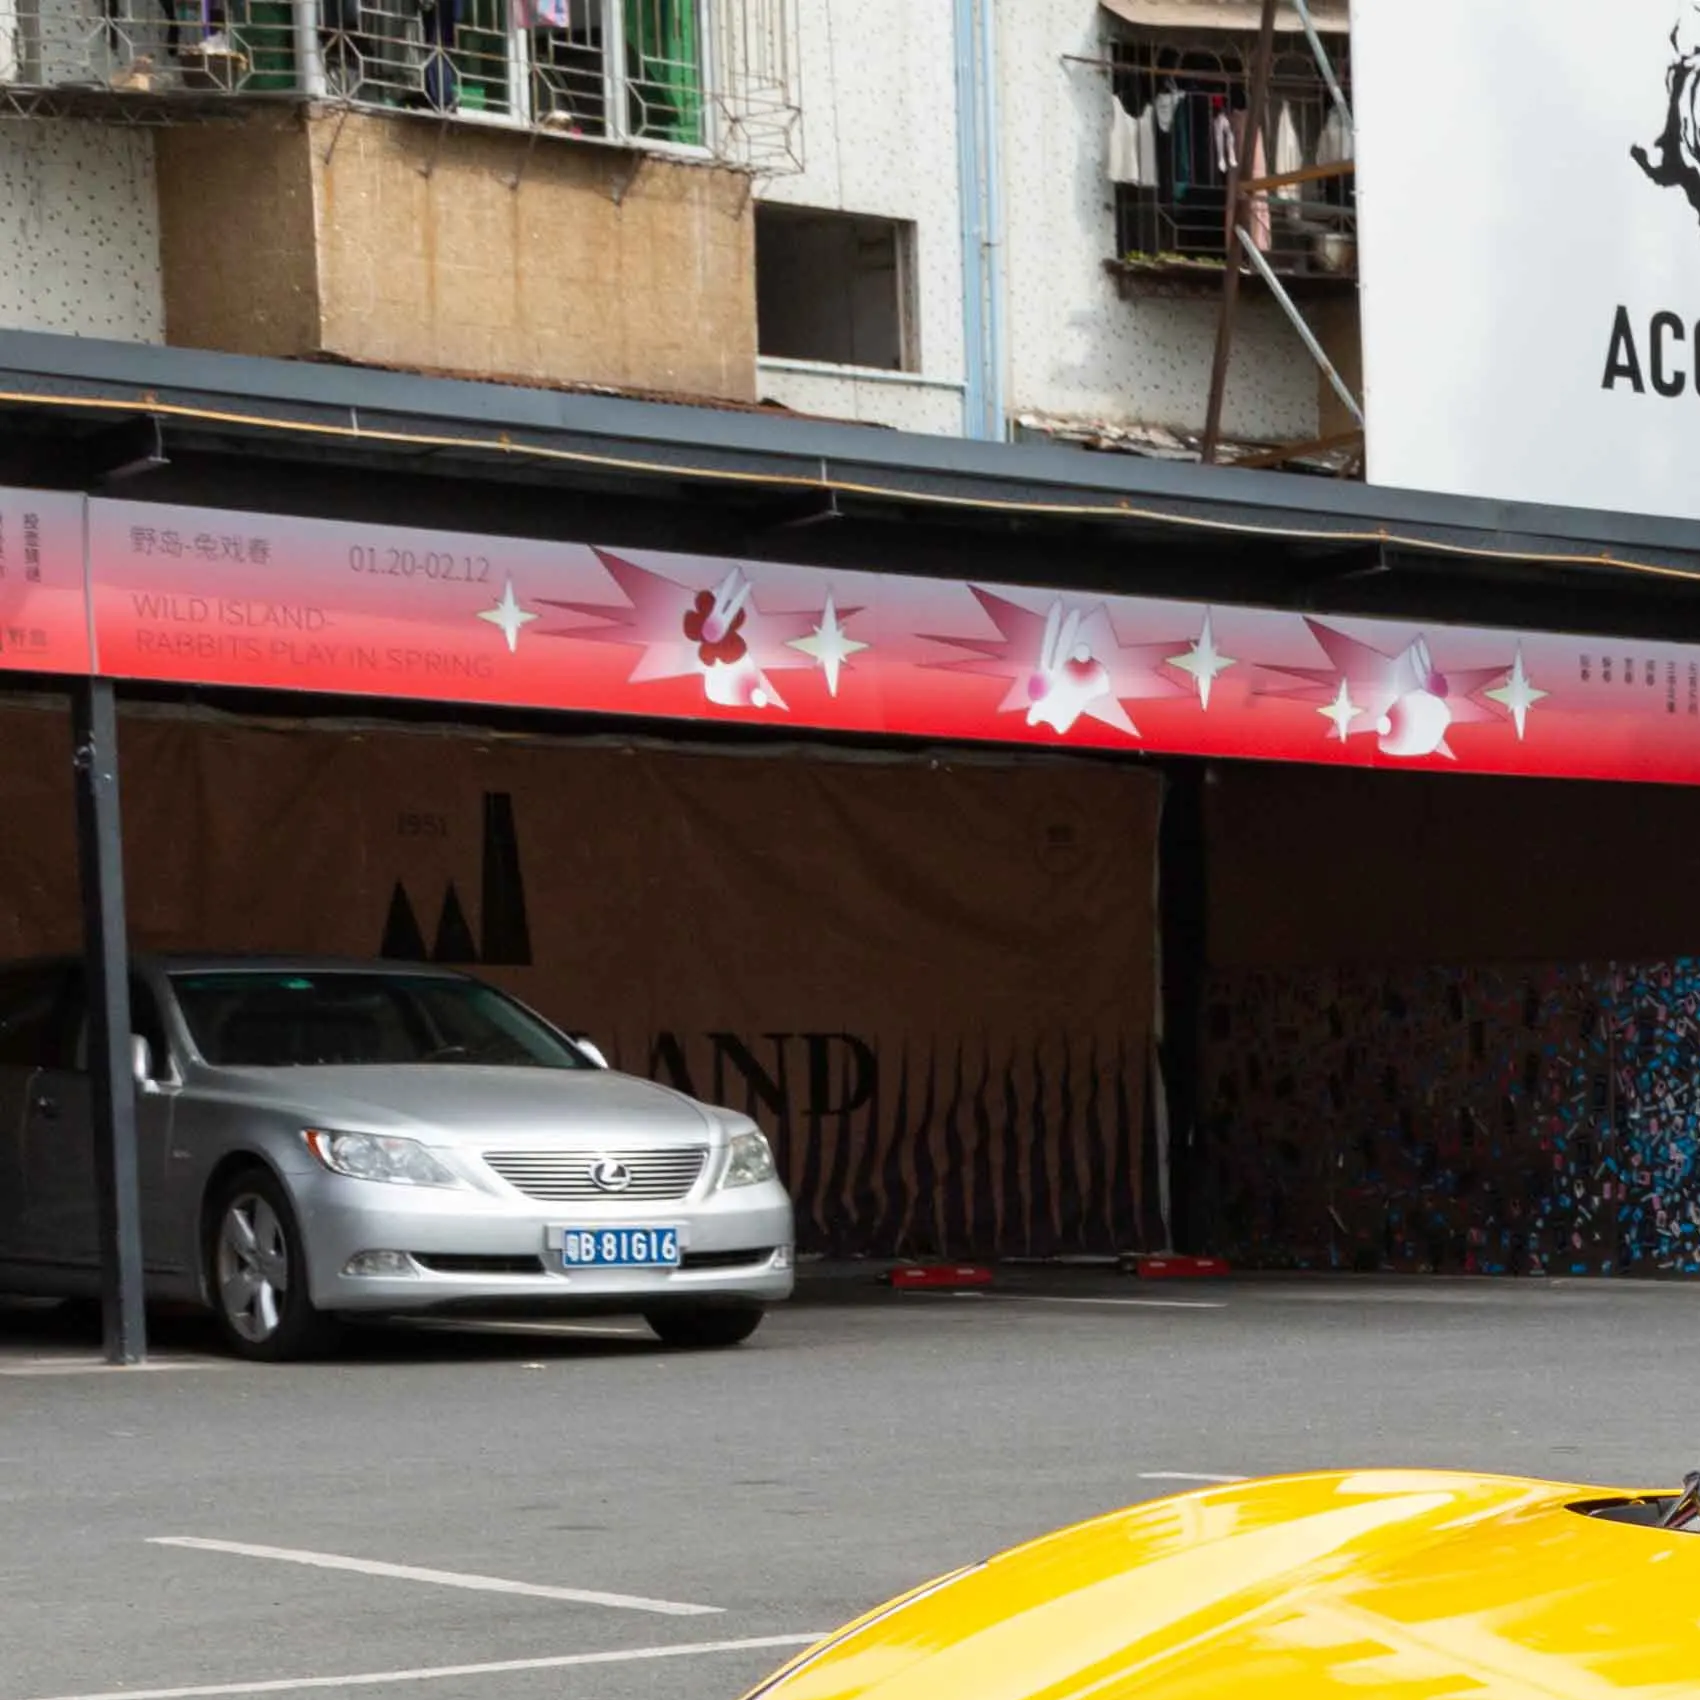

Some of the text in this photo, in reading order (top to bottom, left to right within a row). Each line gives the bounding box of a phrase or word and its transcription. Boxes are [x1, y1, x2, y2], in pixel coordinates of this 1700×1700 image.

[350, 545, 491, 584] 01.20-02.12
[132, 593, 209, 624] WILD
[135, 628, 494, 680] RABBITS PLAY IN SPRING
[572, 1029, 878, 1116] AND
